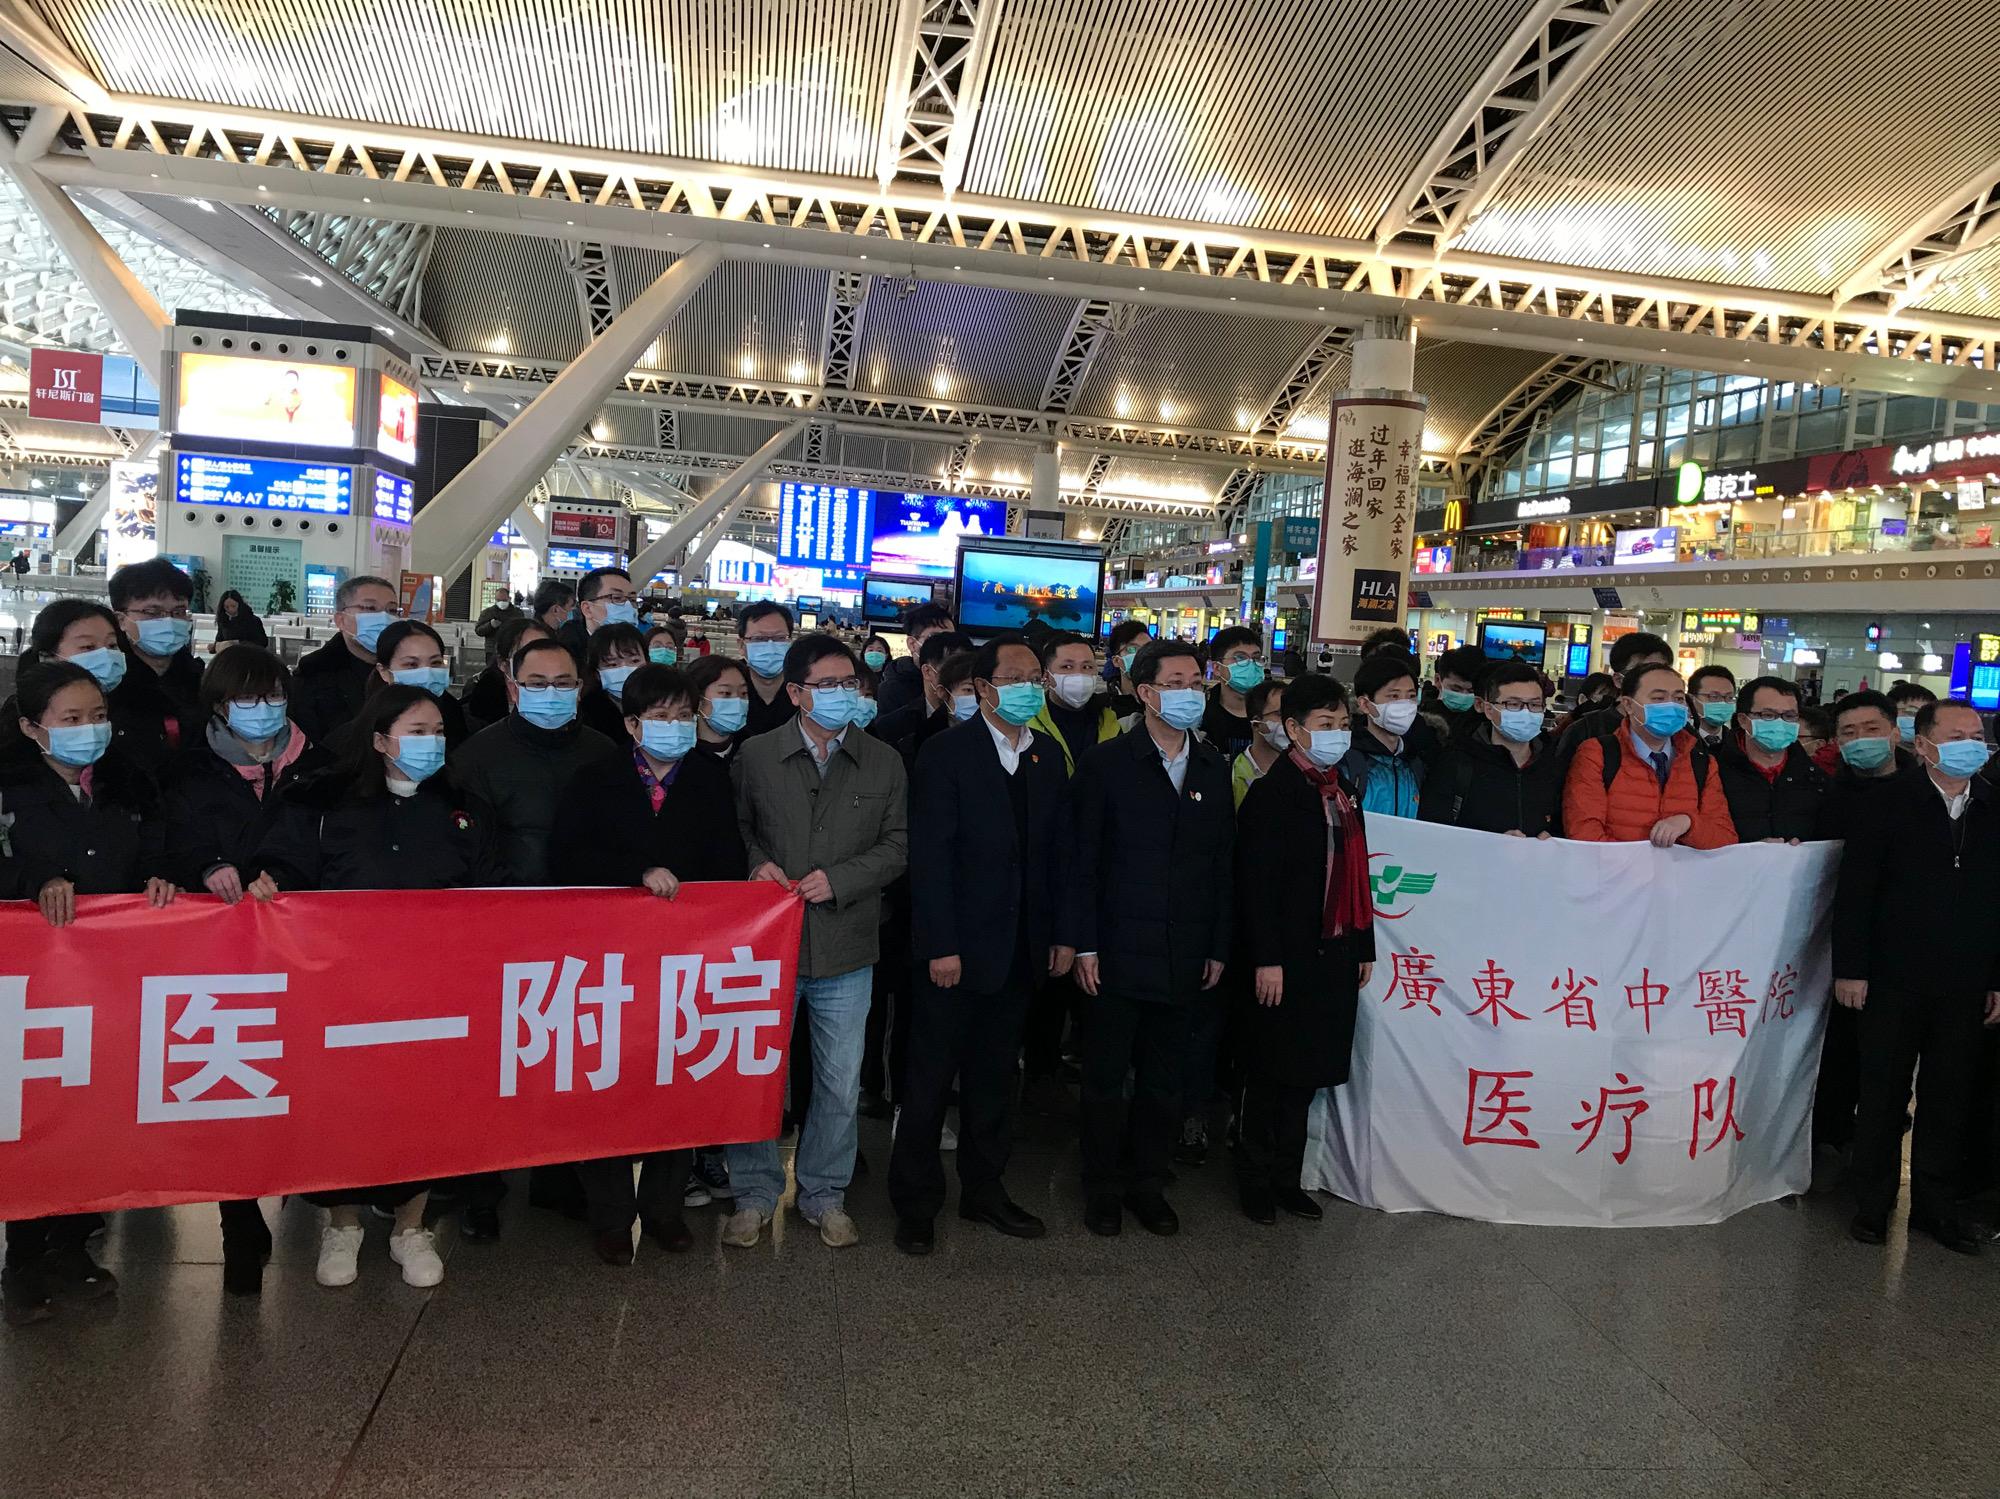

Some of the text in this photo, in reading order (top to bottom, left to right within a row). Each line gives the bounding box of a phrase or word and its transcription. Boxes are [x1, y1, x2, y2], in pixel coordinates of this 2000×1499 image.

[36, 388, 95, 404] 轩尼斯门窗
[1342, 438, 1367, 556] 逛海澜之家
[1366, 424, 1391, 519] 过年回家
[1390, 439, 1412, 559] 幸福至全家
[1703, 471, 1757, 501] 德克士
[1357, 597, 1395, 611] 海澜之家
[1360, 581, 1396, 597] HLA
[1382, 947, 1799, 1038] 廣東省中醫院
[0, 946, 783, 1142] 中医一附院
[1461, 1068, 1746, 1165] 医疗队
